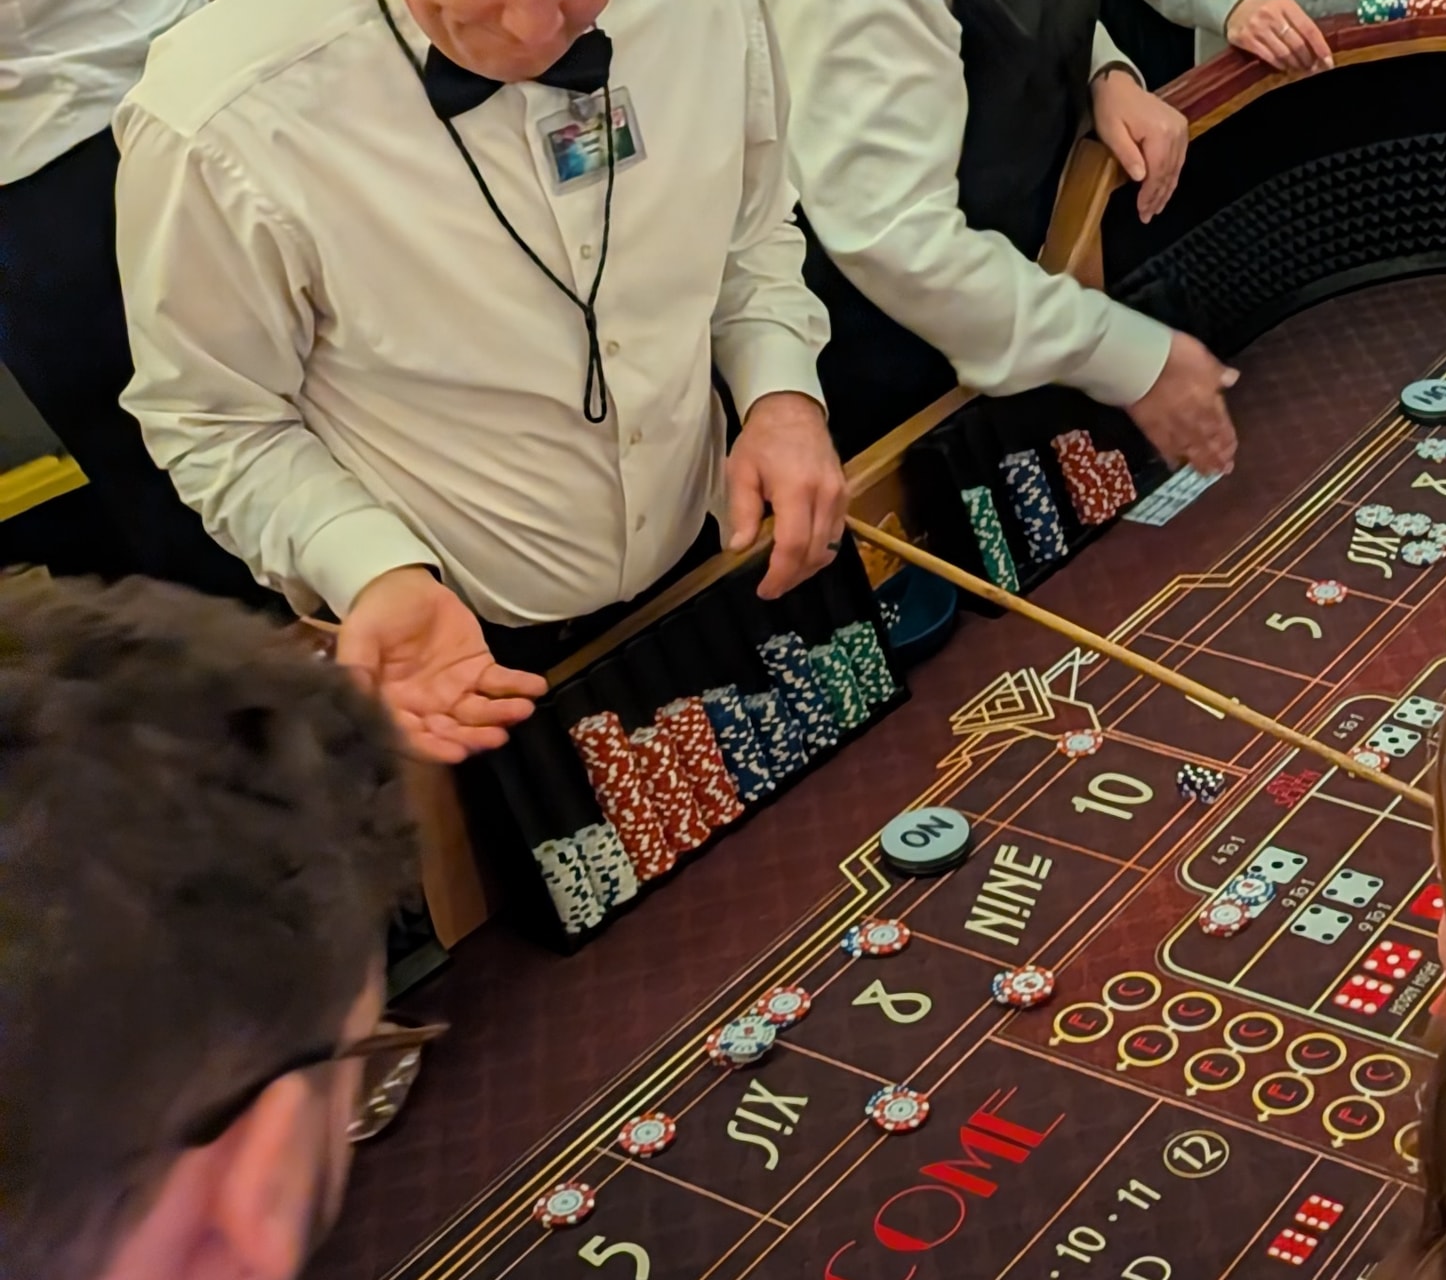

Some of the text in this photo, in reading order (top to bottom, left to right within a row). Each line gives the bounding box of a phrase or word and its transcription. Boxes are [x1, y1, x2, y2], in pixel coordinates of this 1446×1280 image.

[1346, 527, 1401, 579] SIX
[1265, 612, 1323, 640] 5
[1071, 772, 1154, 820] 10
[900, 815, 955, 848] ON
[964, 844, 1053, 946] NINE
[1281, 898, 1297, 908] 9
[1358, 922, 1373, 932] 9
[851, 978, 932, 1024] 8
[726, 1078, 809, 1171] SIX
[1056, 1225, 1107, 1263] 10
[1117, 1178, 1162, 1211] 11
[1171, 1135, 1225, 1170] 12
